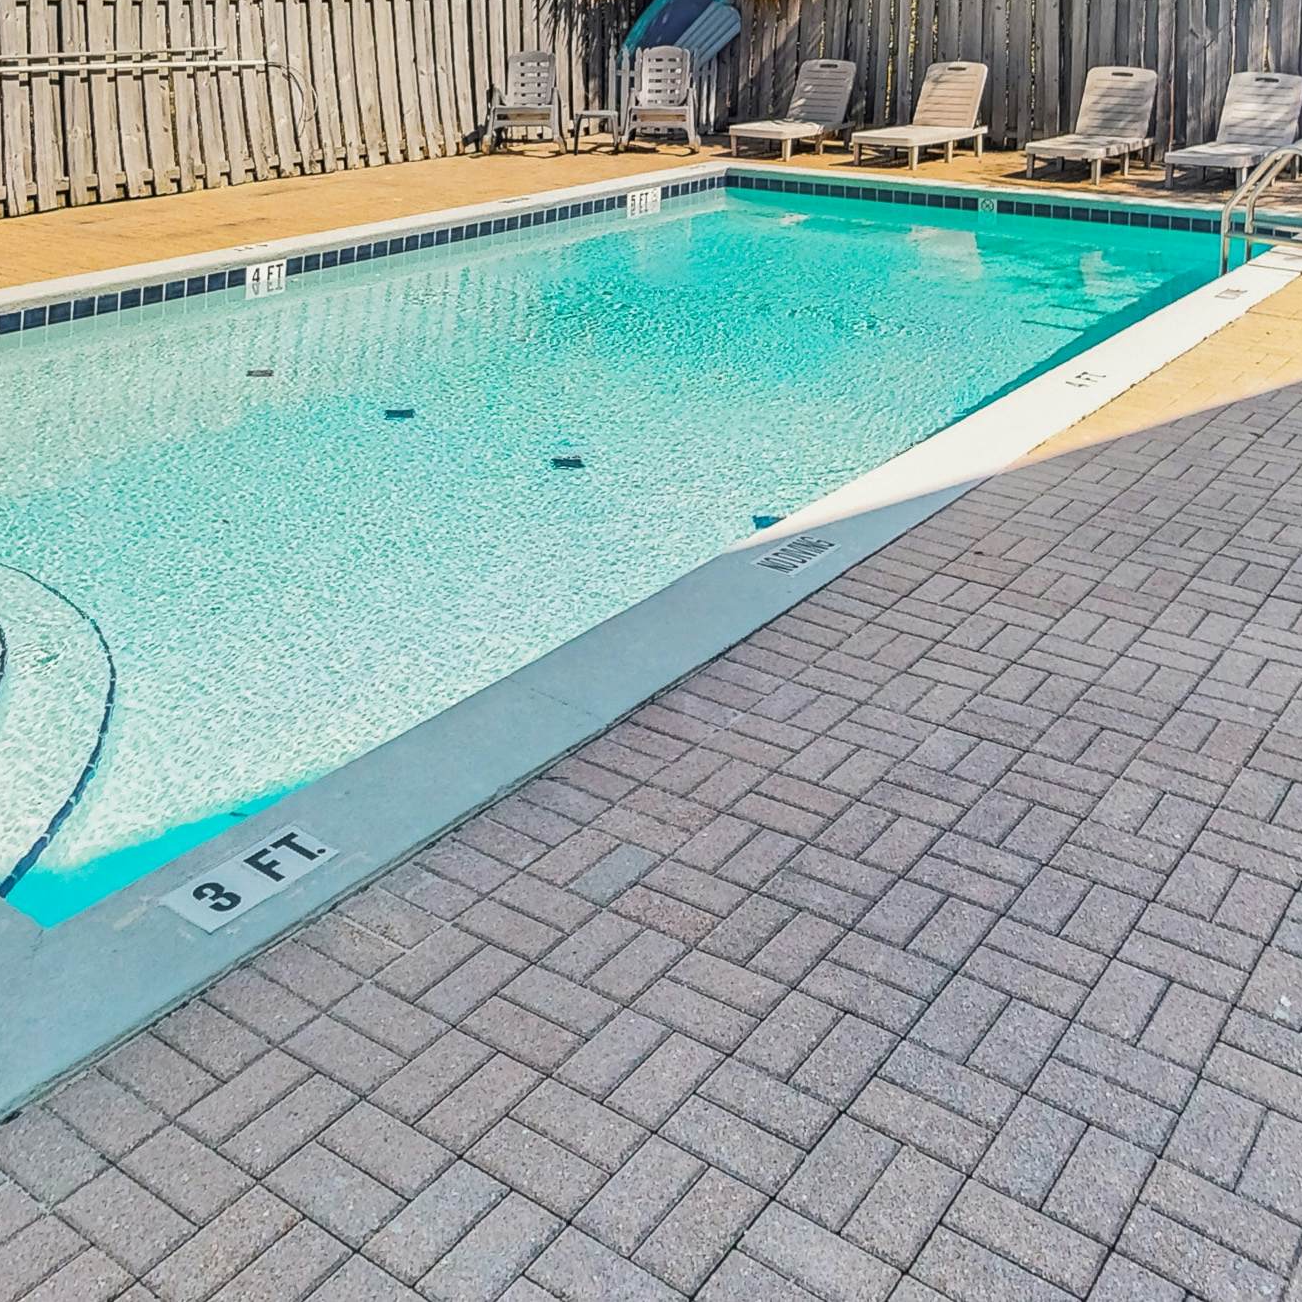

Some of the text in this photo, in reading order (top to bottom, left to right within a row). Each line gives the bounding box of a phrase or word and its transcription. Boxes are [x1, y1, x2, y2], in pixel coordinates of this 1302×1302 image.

[252, 263, 284, 282] 4 FT
[756, 536, 835, 574] NO DIVING
[192, 832, 326, 912] 3 FT.
